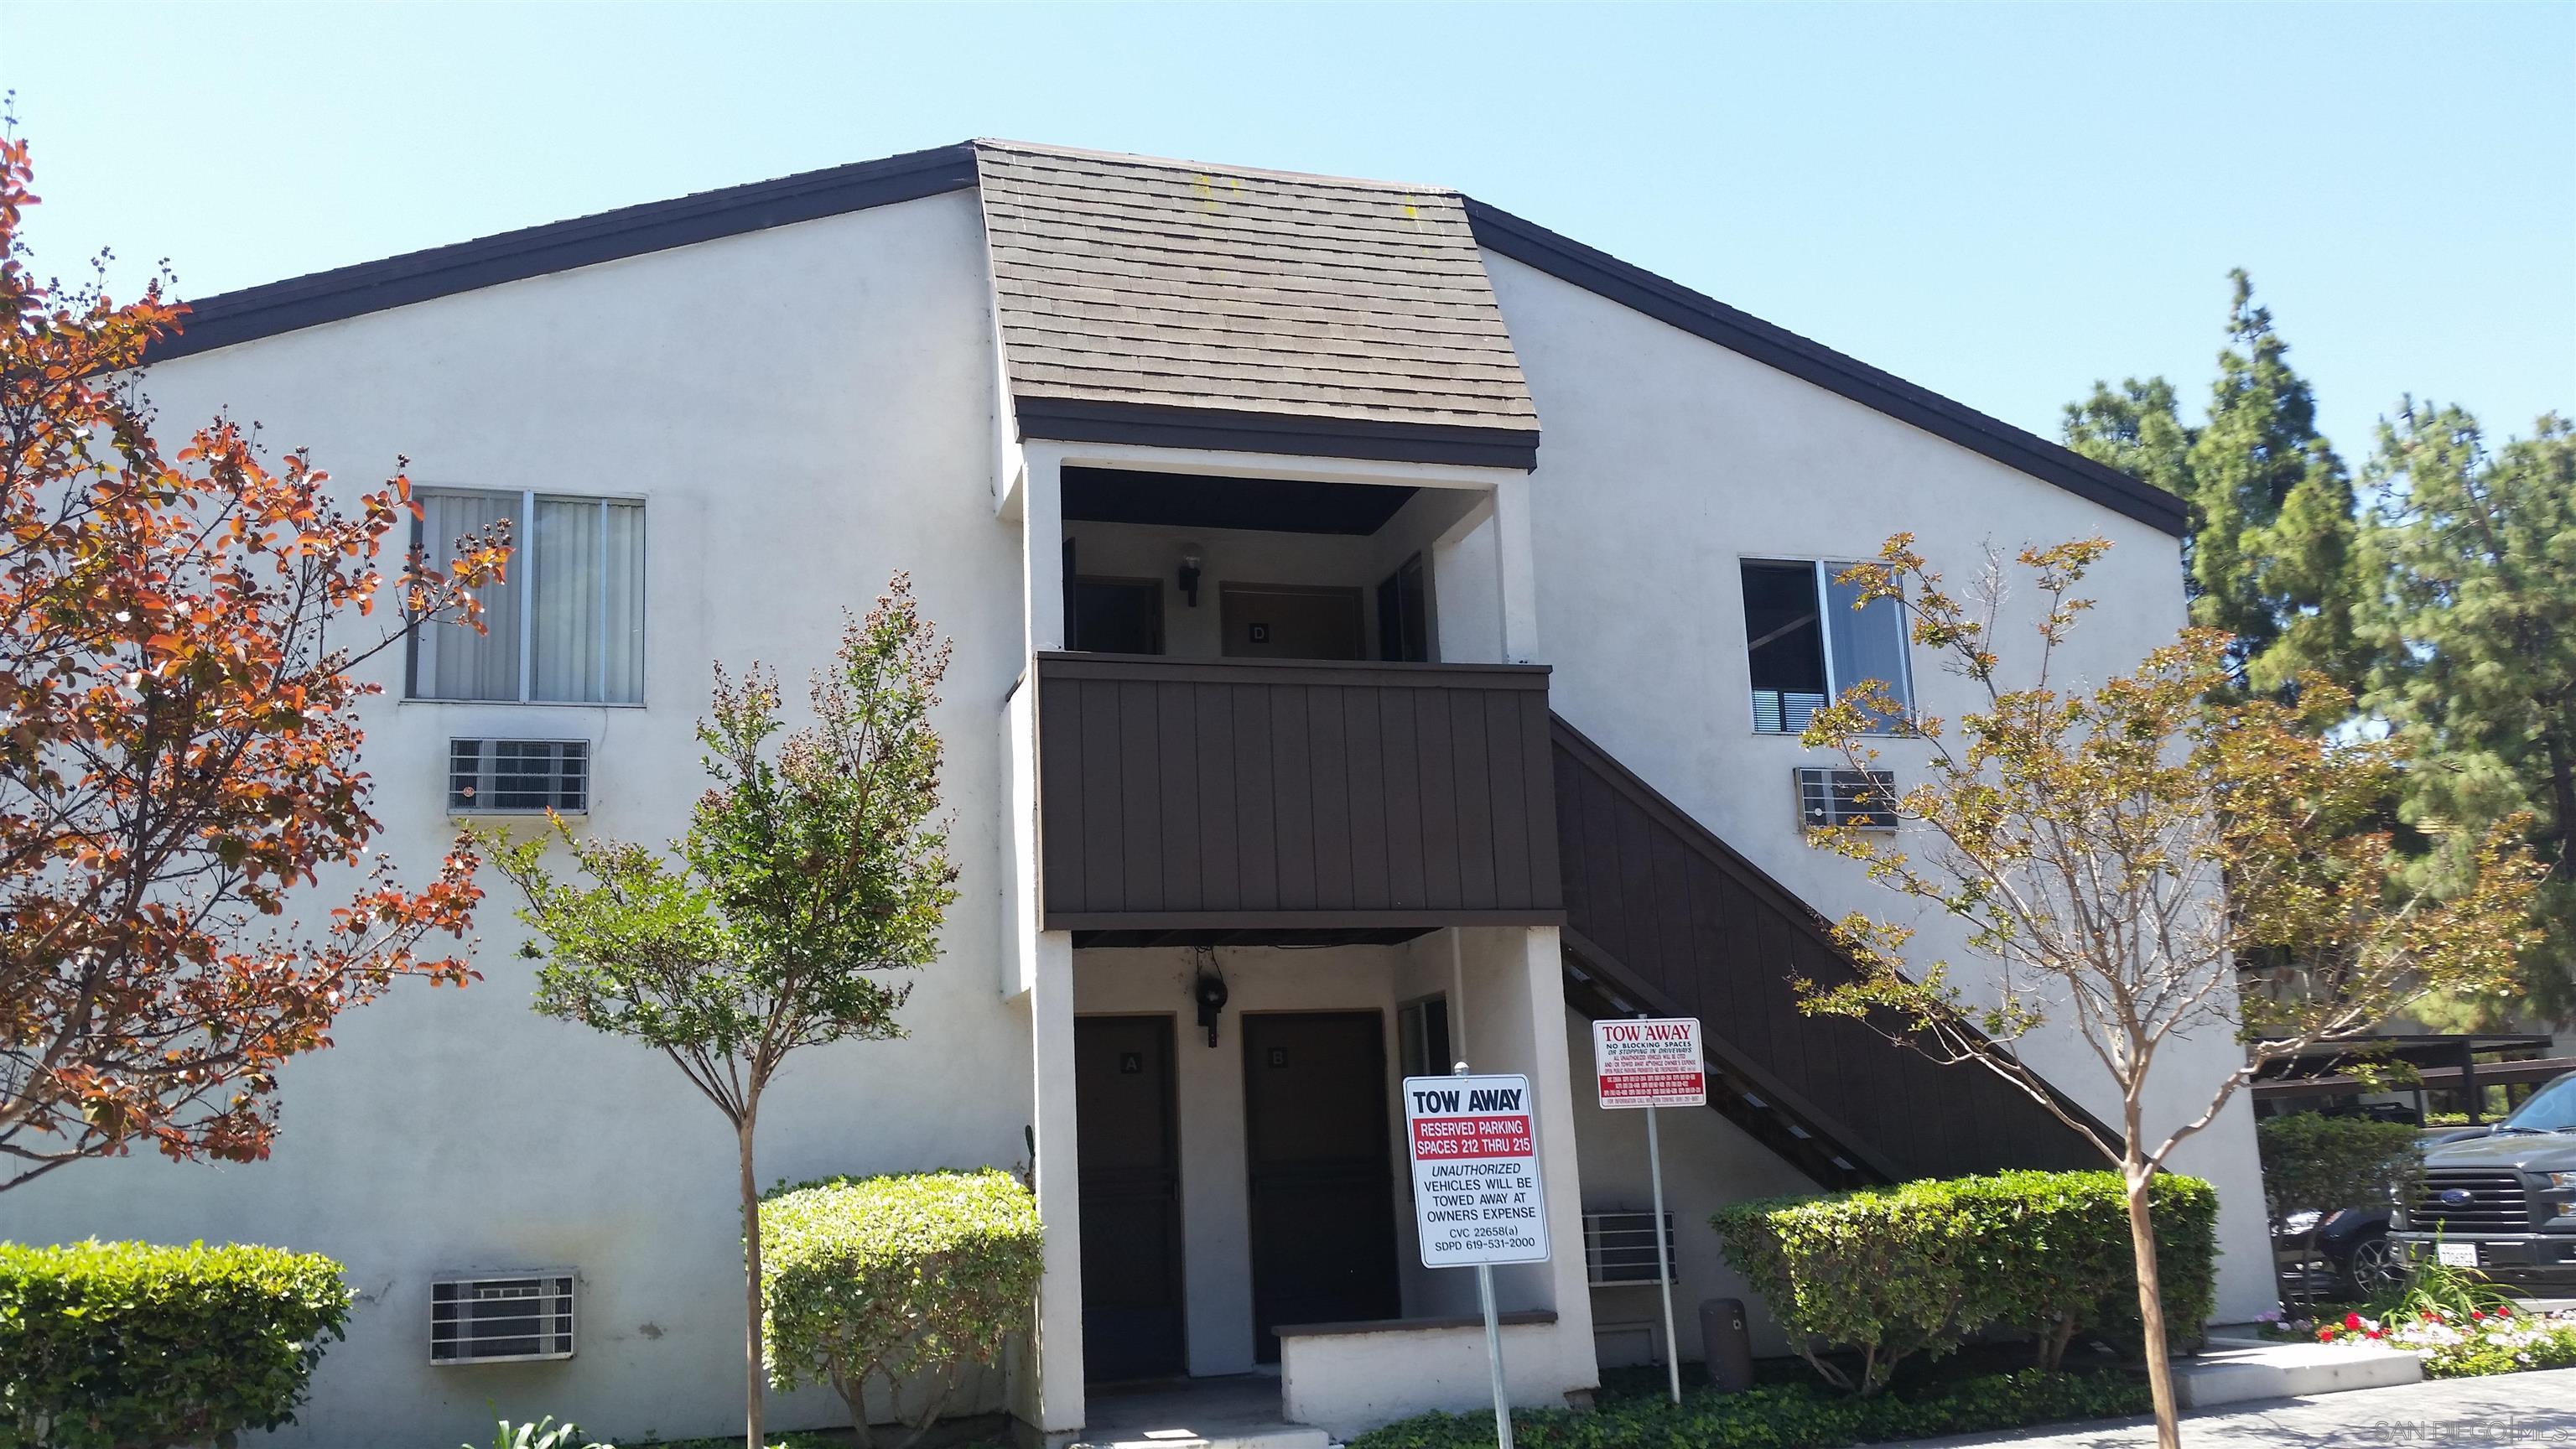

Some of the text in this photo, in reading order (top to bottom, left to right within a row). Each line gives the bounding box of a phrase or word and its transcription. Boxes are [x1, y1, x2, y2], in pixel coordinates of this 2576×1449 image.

[1254, 627, 1265, 639] D
[1602, 1025, 1691, 1041] TOW AWAY
[1125, 1057, 1137, 1071] A
[1273, 1051, 1283, 1064] B
[1413, 1088, 1522, 1114] TOW AWAY
[1420, 1120, 1523, 1136] RESERVED PARKING
[1417, 1137, 1530, 1155] SPACES 212 THRU 215
[1432, 1163, 1521, 1177] UNAUTHORIZED
[1424, 1177, 1532, 1192] VEHICLES WILL BE
[1432, 1192, 1526, 1207] TOWED AWAY AT
[1427, 1207, 1536, 1223] OWNERS EXPENSE
[1449, 1225, 1519, 1239] CVC 22658(a)
[1435, 1237, 1535, 1251] SDPD 619-531-2000
